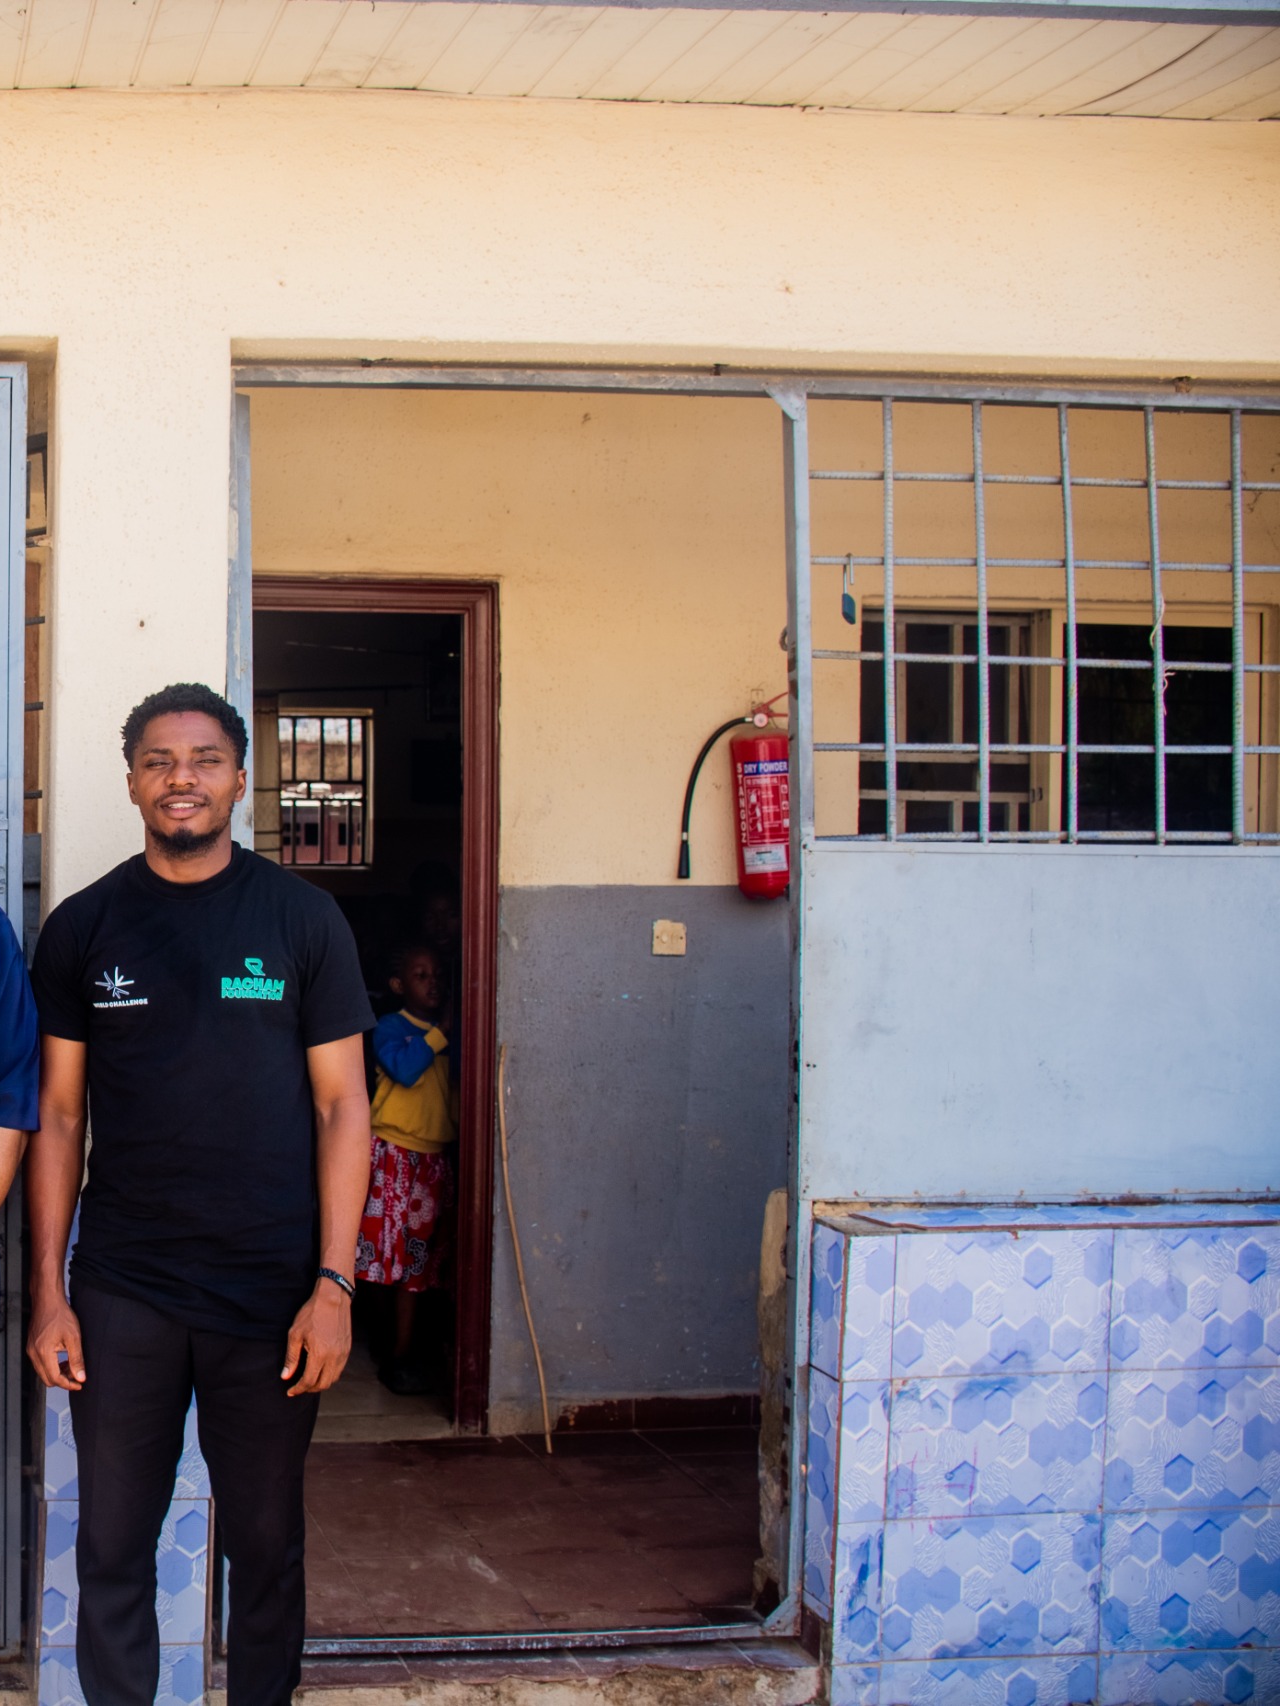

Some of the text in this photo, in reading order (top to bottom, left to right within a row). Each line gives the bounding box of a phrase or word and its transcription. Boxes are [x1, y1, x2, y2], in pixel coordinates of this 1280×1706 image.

[744, 761, 788, 774] DRY POWDER
[221, 977, 285, 992] RACHAM
[221, 989, 284, 1001] FOUNDATION
[109, 998, 148, 1008] CHALLENGE
